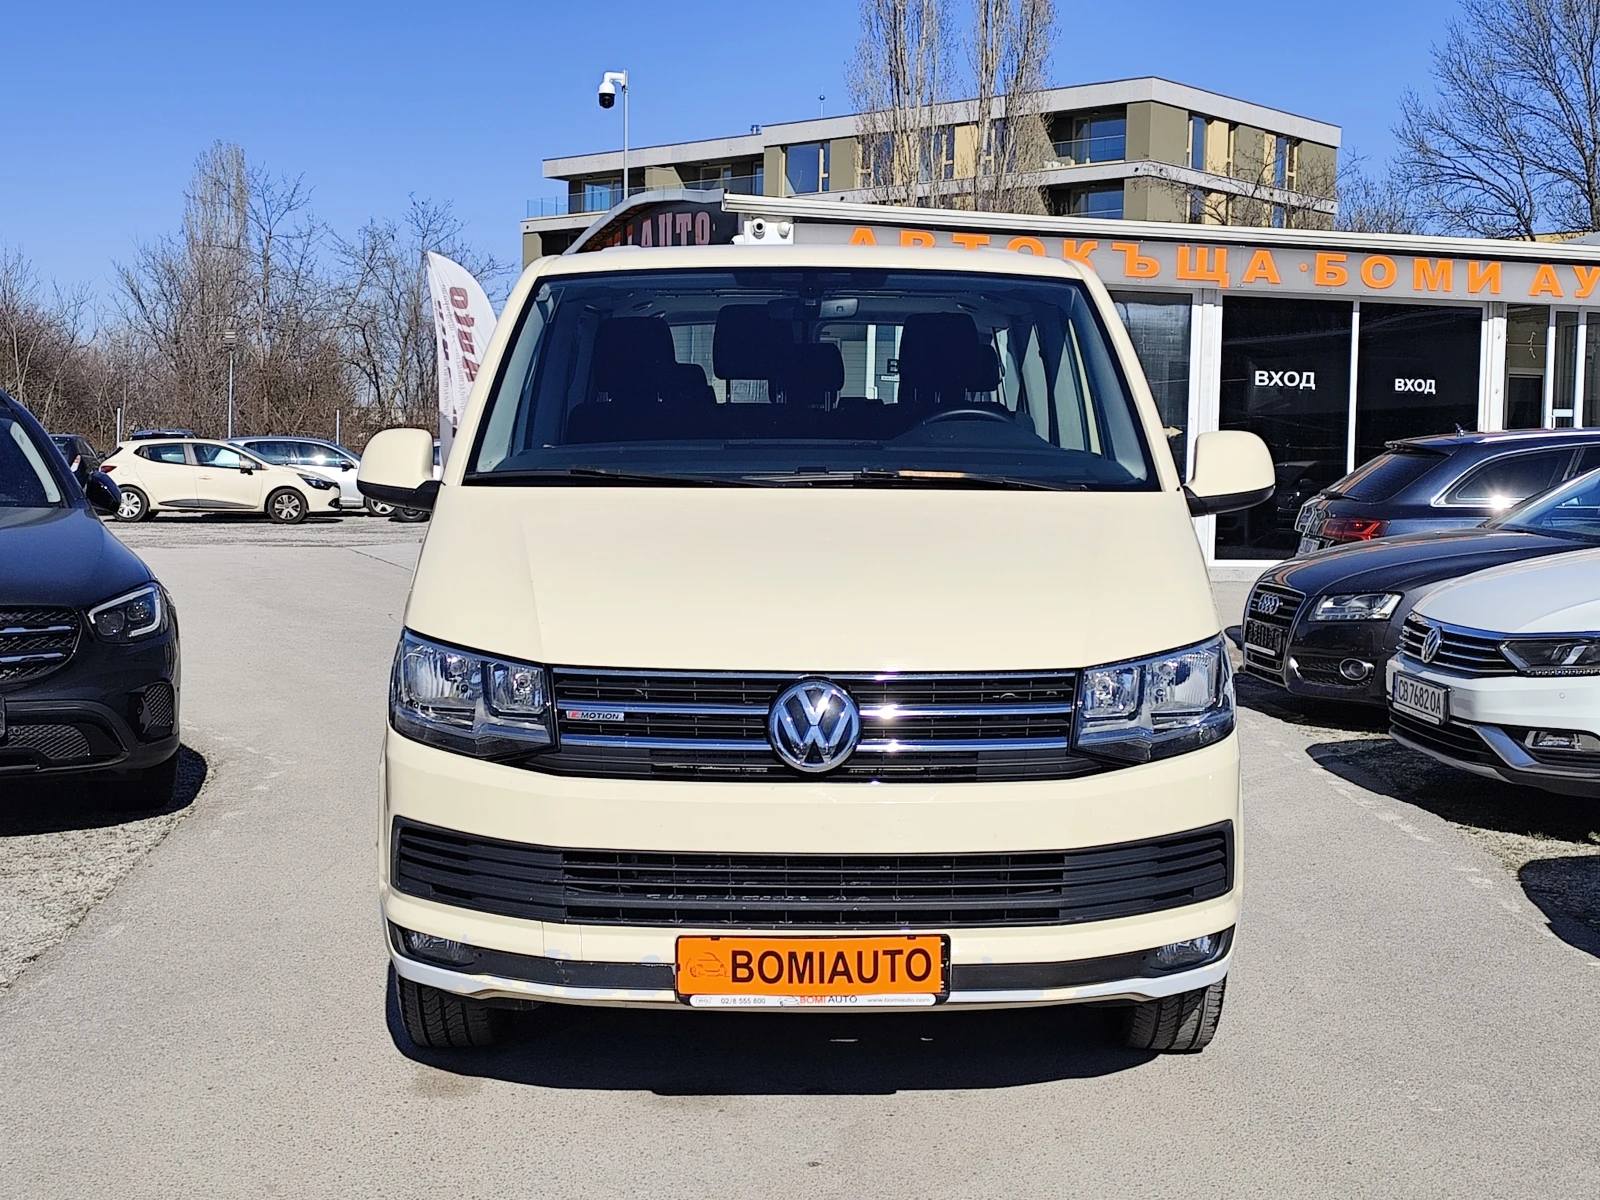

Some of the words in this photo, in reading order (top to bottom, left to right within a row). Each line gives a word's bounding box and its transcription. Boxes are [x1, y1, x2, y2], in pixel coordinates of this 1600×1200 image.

[1314, 252, 1503, 295] БОМИ
[1254, 370, 1316, 390] ВХОД
[1394, 378, 1436, 394] ВХОД
[731, 947, 932, 985] BOMIAUTO
[799, 995, 826, 1004] BOMI
[828, 994, 858, 1004] AUTO
